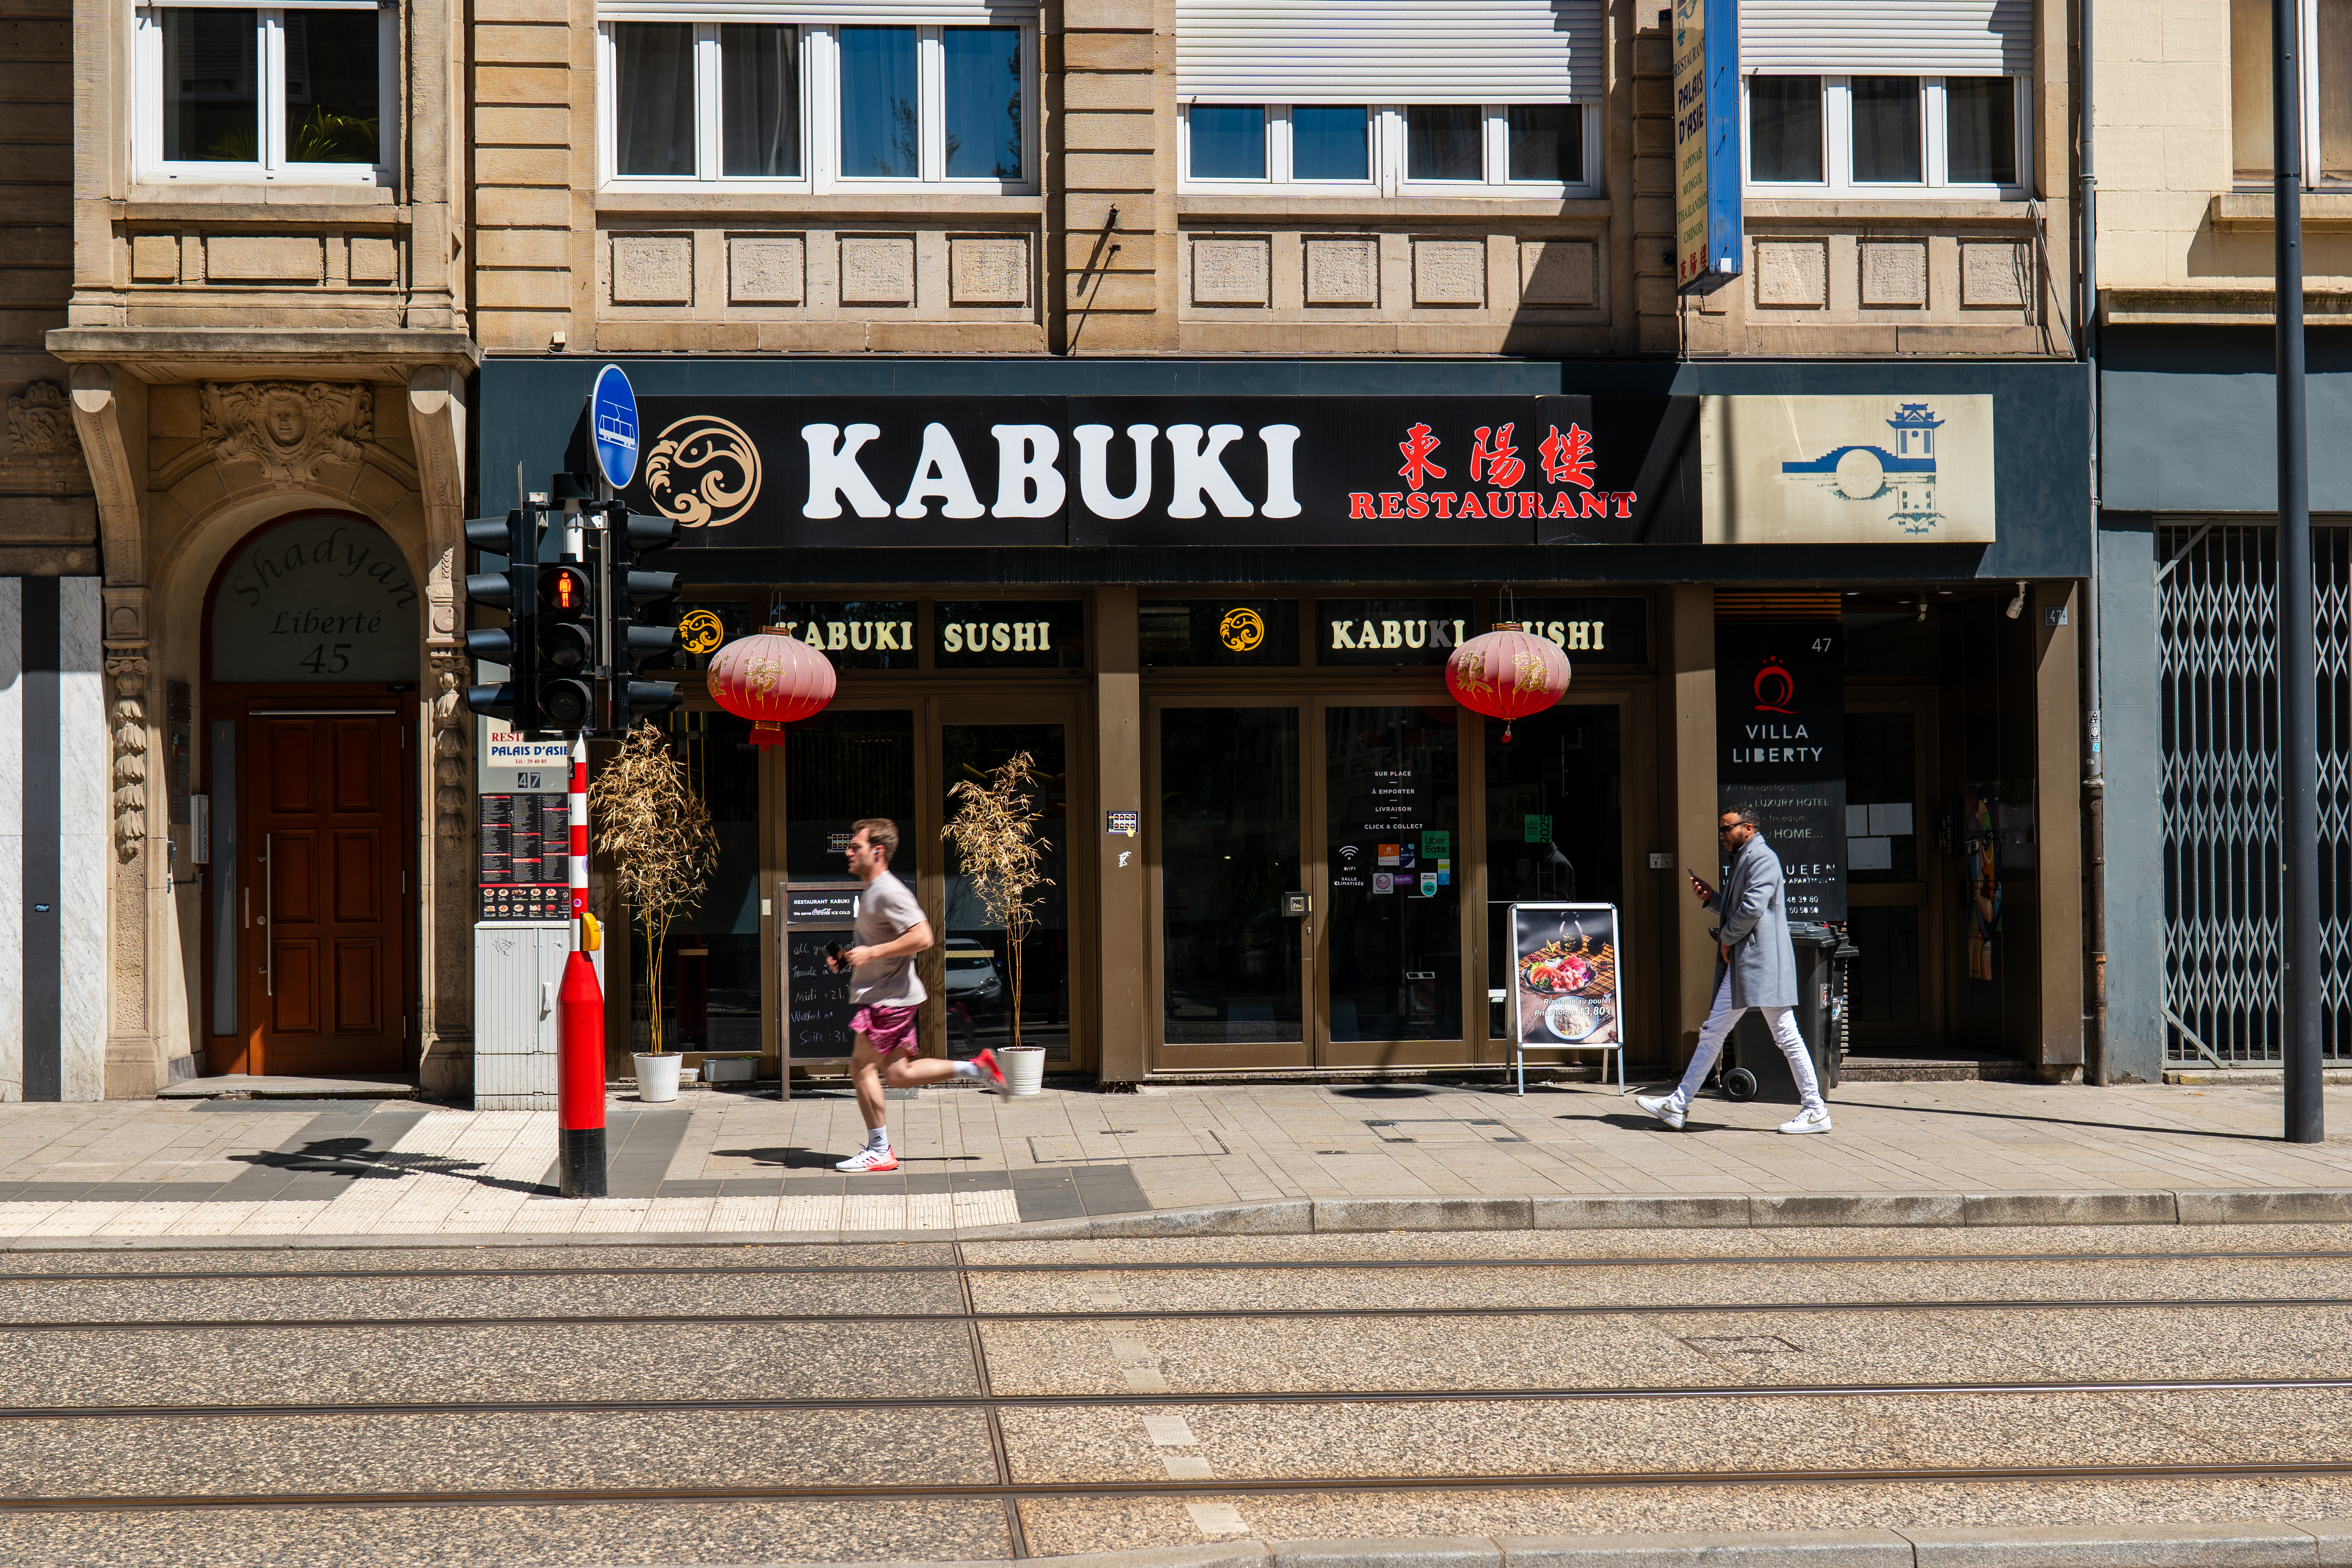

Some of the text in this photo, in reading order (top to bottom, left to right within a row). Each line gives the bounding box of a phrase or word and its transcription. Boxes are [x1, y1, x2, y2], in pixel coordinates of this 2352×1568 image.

[1674, 36, 1705, 79] RESTAURANT
[1678, 69, 1703, 113] PALAIS
[1679, 102, 1704, 145] D'ASIE
[1682, 146, 1702, 177] JAPONAIS
[1683, 171, 1702, 197] MONGOL
[1677, 191, 1707, 224] THAILANDAIS
[1684, 220, 1703, 244] CHINOIS
[1398, 422, 1597, 490] 東陽樓
[802, 423, 1301, 519] KABUKI
[1349, 491, 1637, 519] RESTAURANT
[233, 526, 418, 610] Shadyan
[269, 608, 382, 634] Liberté
[2050, 610, 2062, 622] 47
[944, 622, 1051, 652] SUSHI
[1332, 619, 1604, 650] KABUKI USHI
[1812, 638, 1831, 652] 47
[300, 643, 352, 674] 45
[1746, 724, 1809, 739] VILLA
[492, 746, 568, 757] PALAIS D'ASIE
[1733, 747, 1823, 763] LIBERTY
[518, 773, 540, 787] 47
[1755, 799, 1794, 807] LUXURY
[1797, 798, 1829, 806] HOTEL
[1775, 828, 1823, 838] HOME...
[1786, 864, 1836, 875] UEEN
[795, 987, 817, 1003] Midi
[1578, 1007, 1605, 1016] 13,80
